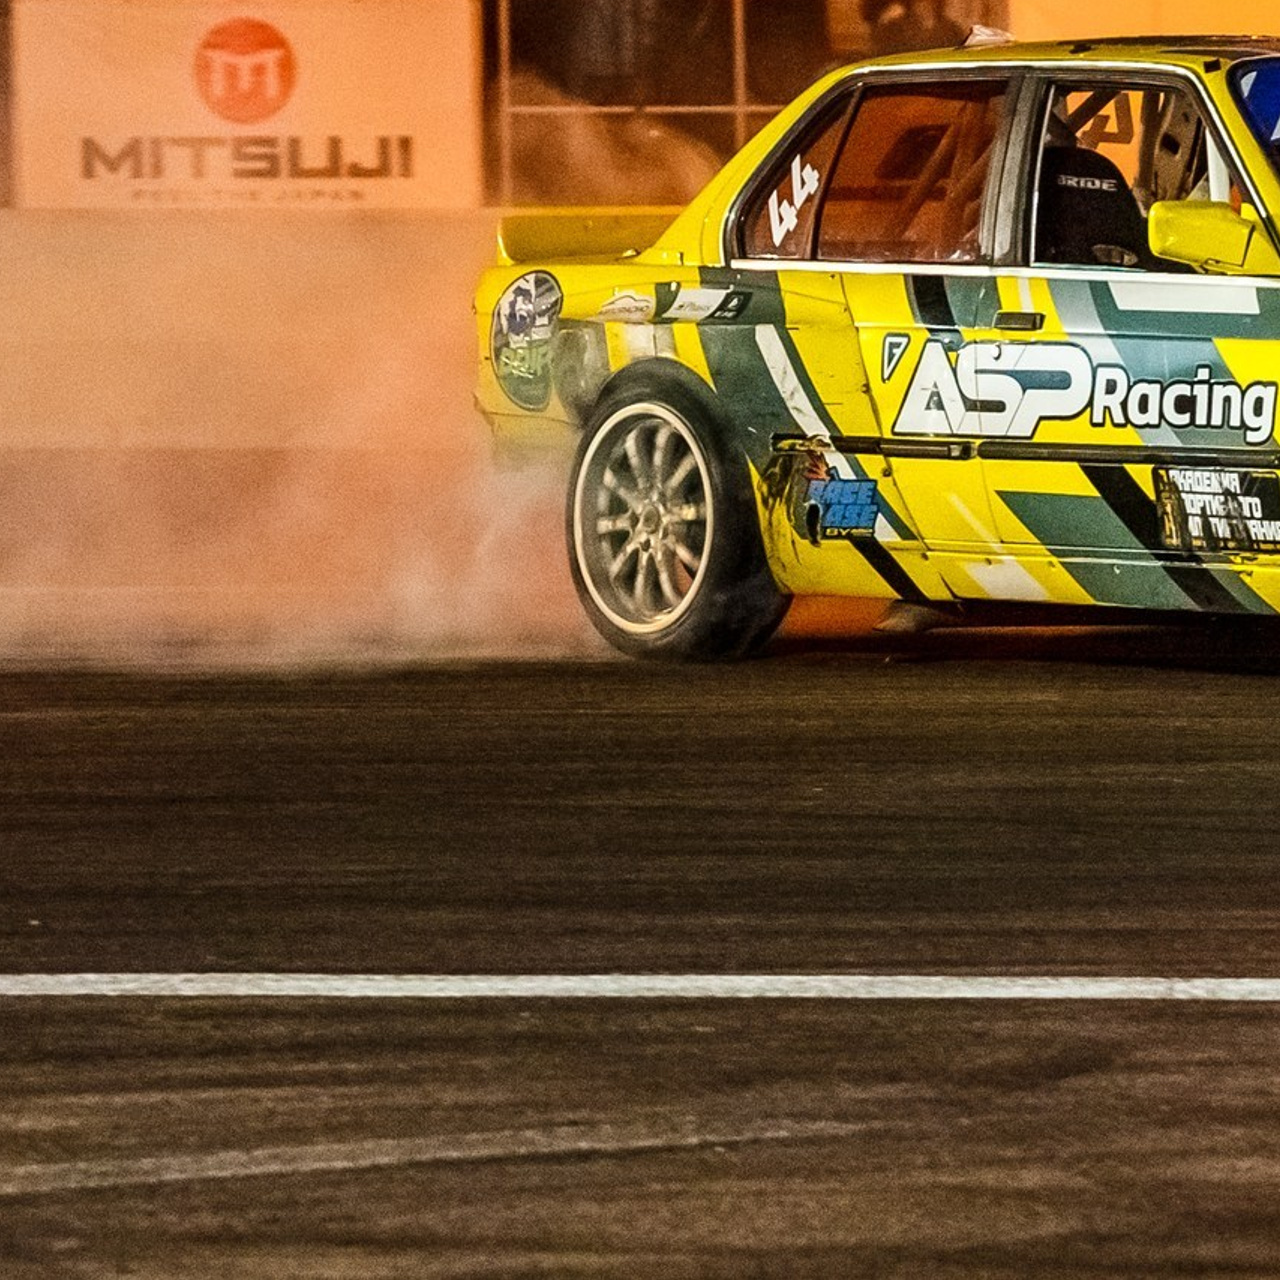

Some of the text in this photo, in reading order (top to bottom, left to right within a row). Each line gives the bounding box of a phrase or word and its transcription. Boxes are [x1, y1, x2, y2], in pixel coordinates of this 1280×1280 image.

[82, 136, 414, 178] MITSUJI
[768, 154, 820, 247] 44
[893, 340, 1278, 442] ASP Racing
